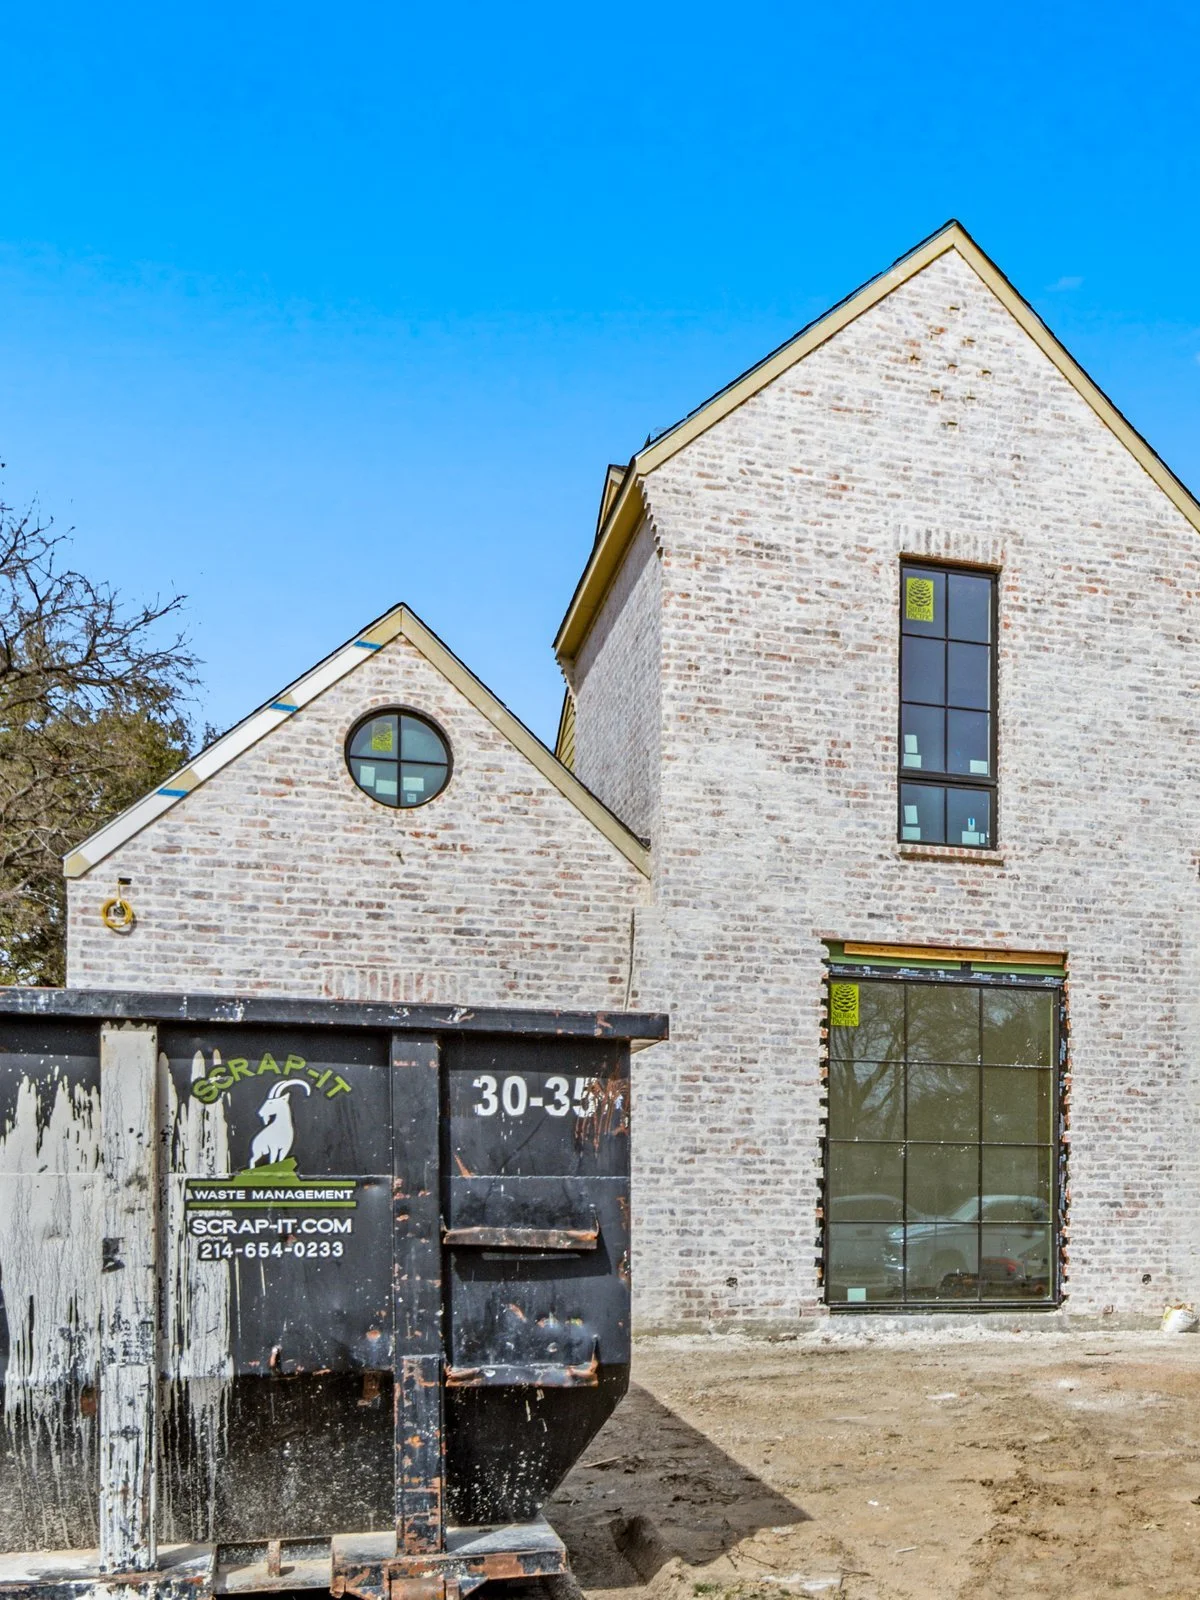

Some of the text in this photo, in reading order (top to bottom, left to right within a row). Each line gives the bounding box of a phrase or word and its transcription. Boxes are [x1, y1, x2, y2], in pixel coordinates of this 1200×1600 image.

[193, 1053, 352, 1101] SCRAP-IT
[473, 1075, 597, 1117] 30-35
[194, 1190, 353, 1200] WASTE MANAGEMENT
[192, 1218, 352, 1234] SCRAP-IT.COM
[201, 1241, 344, 1258] 214-654-0233
